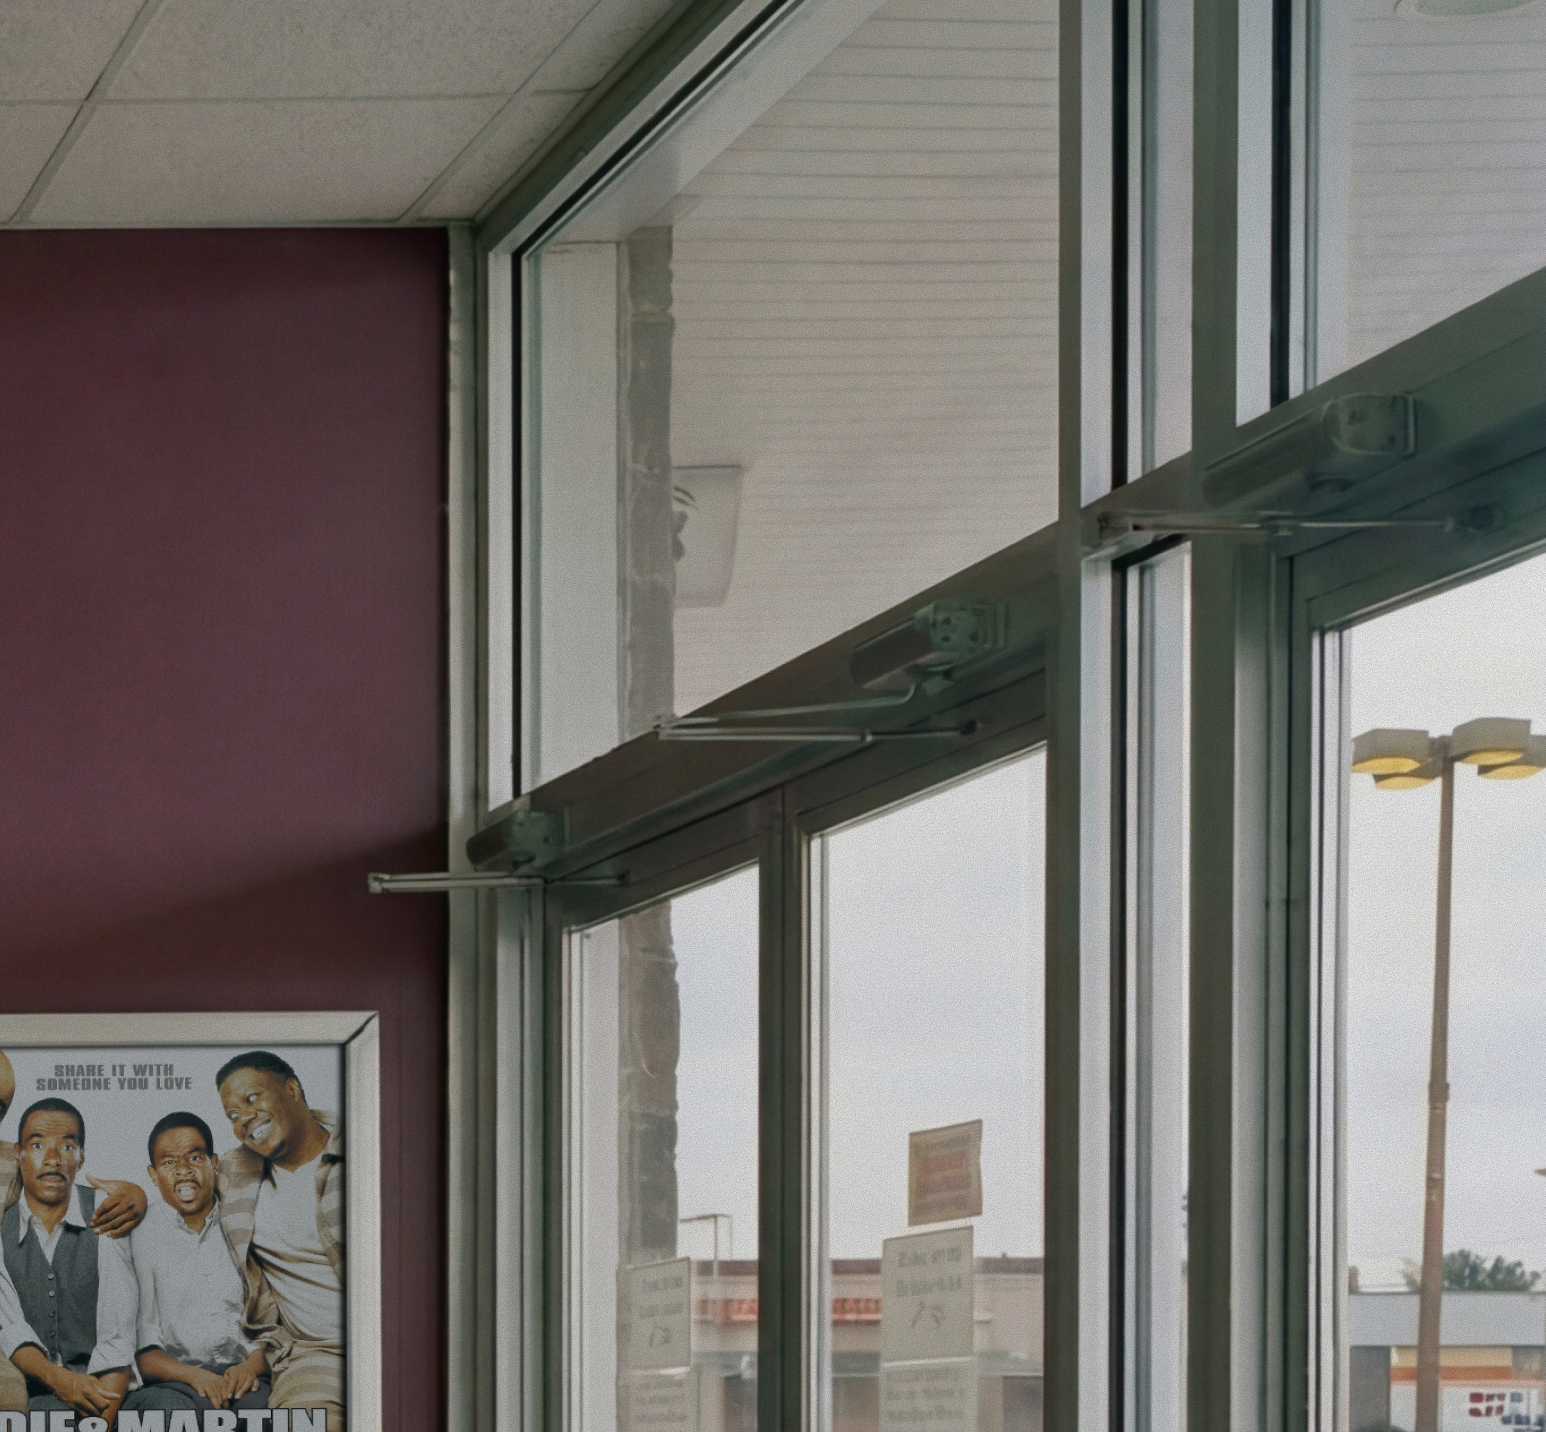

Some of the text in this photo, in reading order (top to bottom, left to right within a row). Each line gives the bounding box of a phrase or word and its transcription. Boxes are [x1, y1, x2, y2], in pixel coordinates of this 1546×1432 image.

[54, 1064, 174, 1077] SHARE IT WITH
[36, 1077, 192, 1091] SOMEONE YOU LOVE
